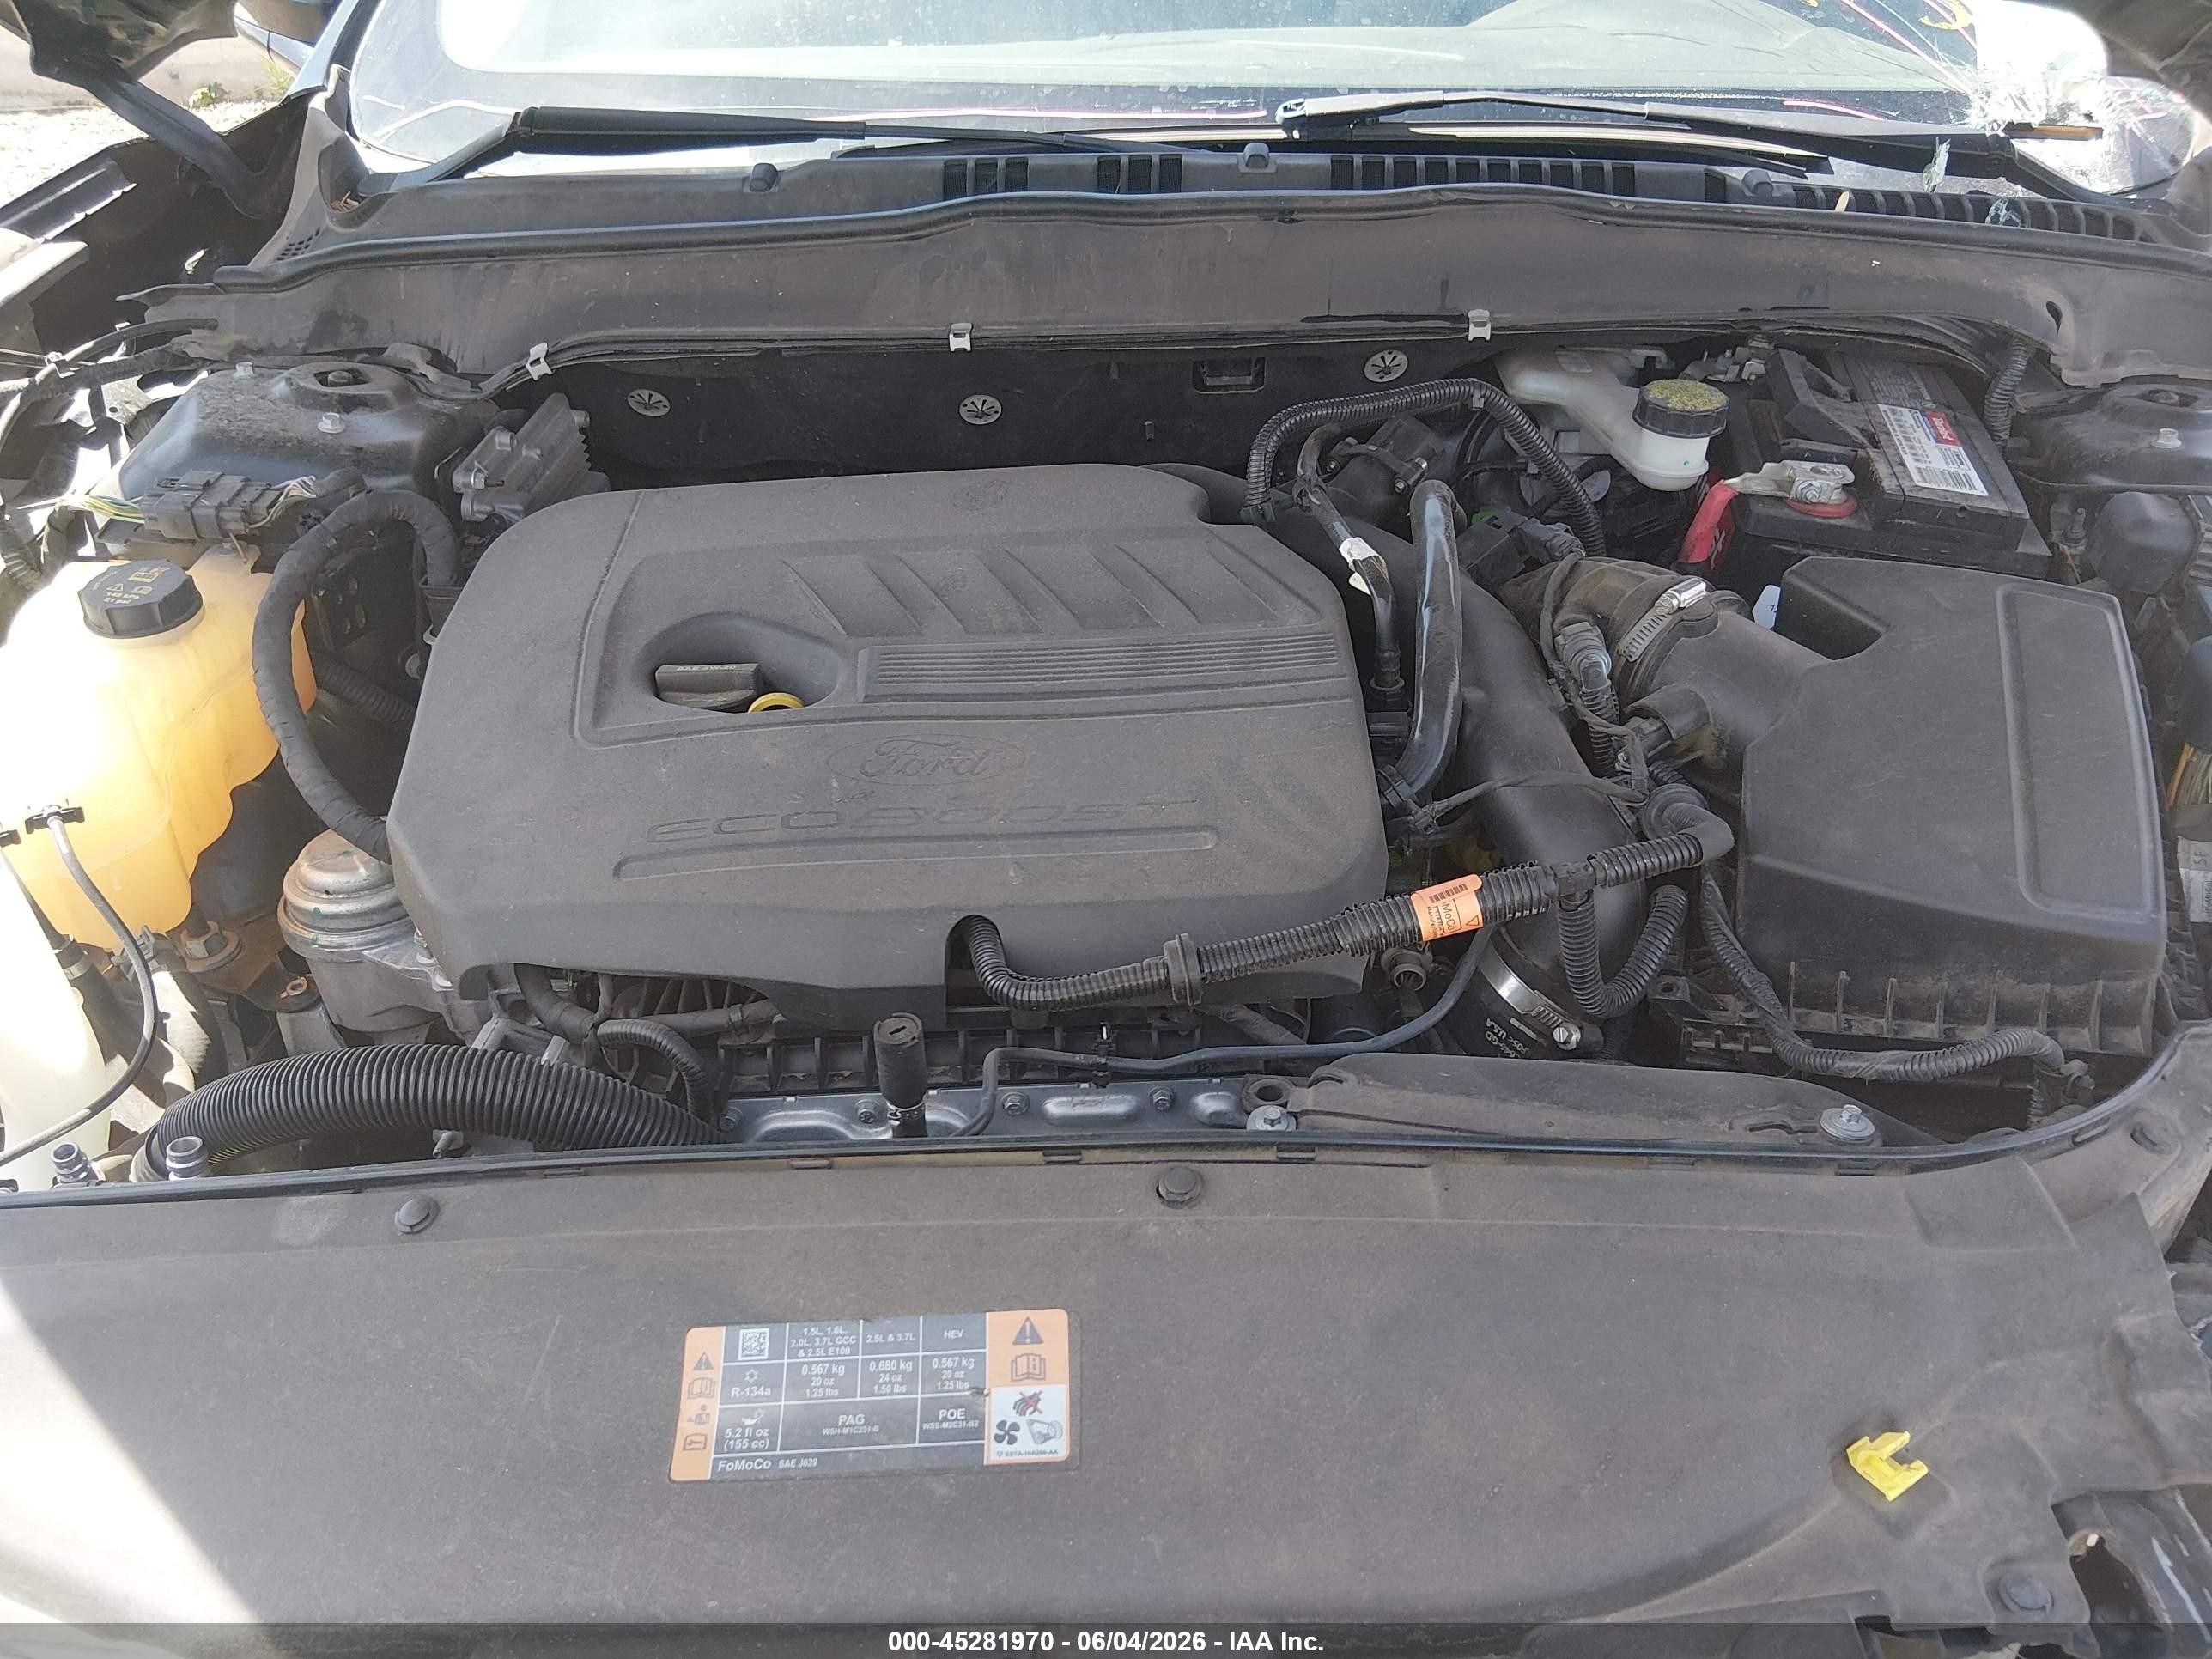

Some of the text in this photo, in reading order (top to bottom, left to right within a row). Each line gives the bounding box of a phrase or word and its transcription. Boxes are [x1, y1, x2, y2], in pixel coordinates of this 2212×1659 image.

[860, 738, 990, 777] Ford
[866, 1332, 916, 1344] 2.5L & 3.7L
[944, 1328, 964, 1340] HEV
[814, 1336, 834, 1346] 3.7L
[835, 1335, 857, 1346] GCC
[798, 1346, 851, 1358] & 2.5L E100
[801, 1363, 845, 1376] 0.567 kg
[869, 1359, 913, 1373] 0.680 kg
[932, 1357, 975, 1370] 0.567 kg
[878, 1373, 902, 1383] 24 oz
[954, 1370, 964, 1379] oz
[811, 1376, 835, 1387] 20 oz
[937, 1380, 969, 1390] 1.25 lbs
[731, 1386, 771, 1398] R-134a
[805, 1387, 839, 1398] 1.25 lbs
[873, 1383, 907, 1395] 1.50 lbs
[838, 1413, 866, 1426] PAG
[939, 1407, 966, 1420] POE
[724, 1426, 770, 1439] 5.2 fl oz
[724, 1437, 770, 1452] (155 cc)
[716, 1457, 772, 1472] FoMoCo
